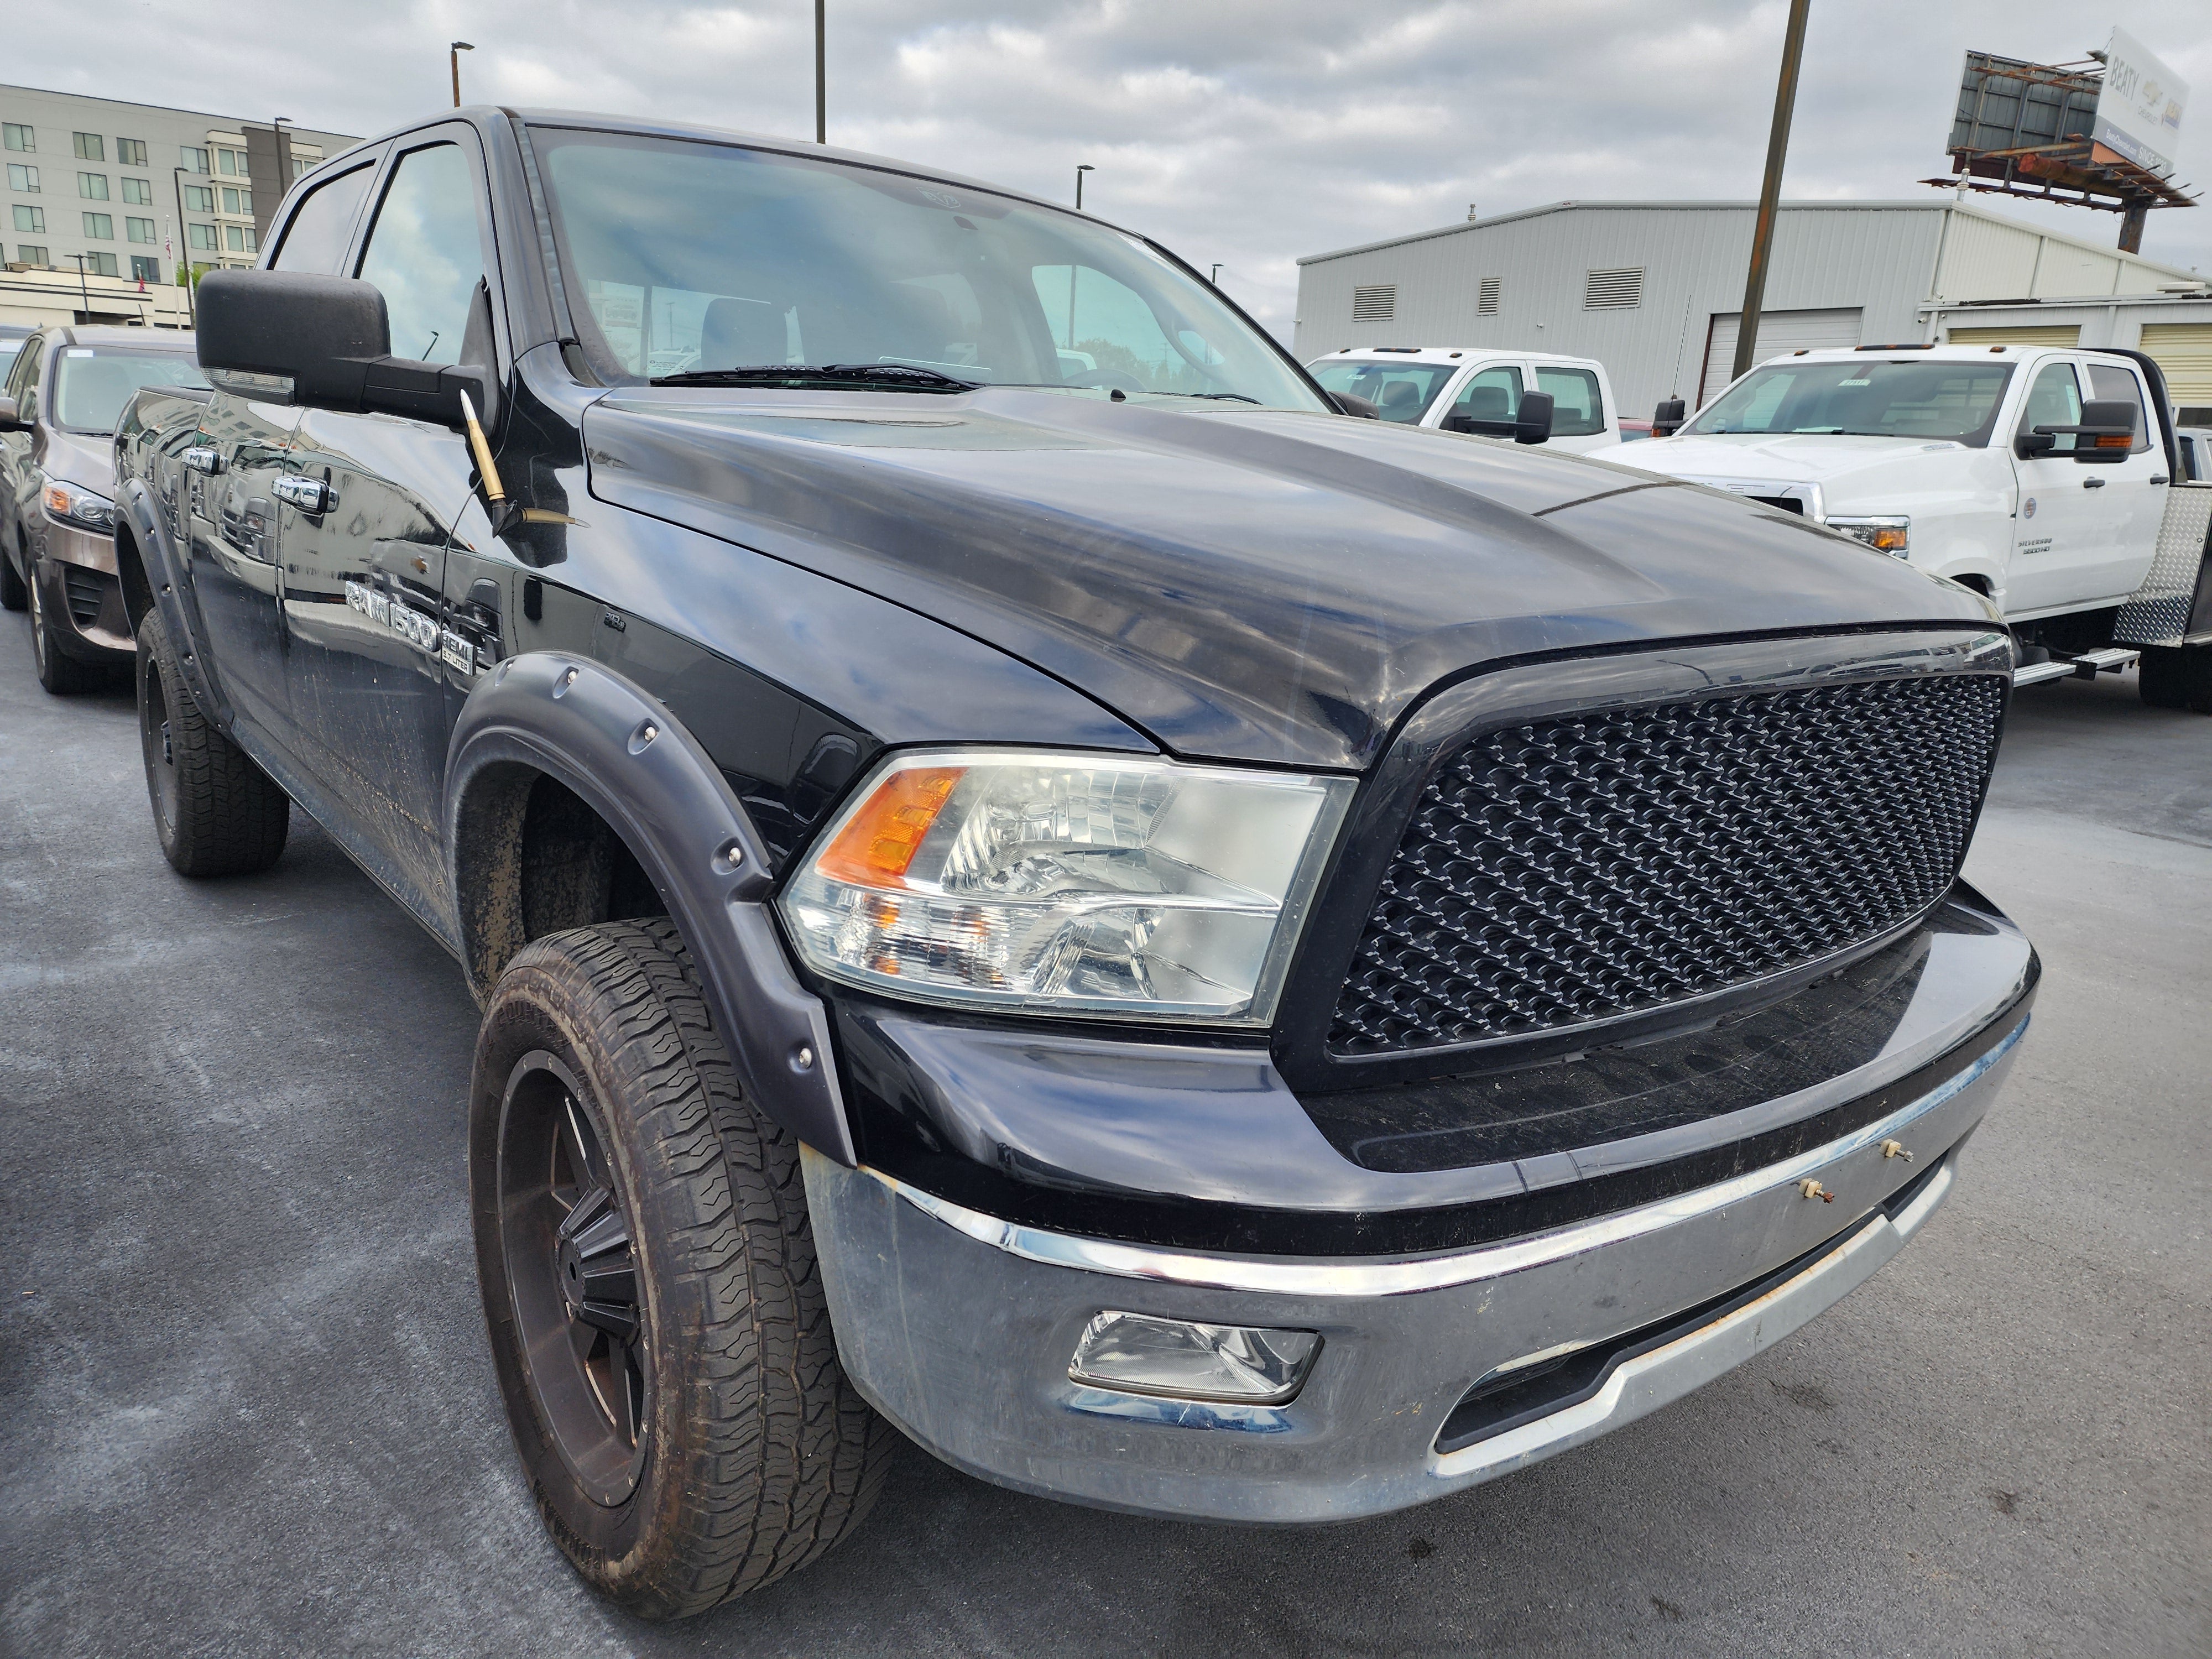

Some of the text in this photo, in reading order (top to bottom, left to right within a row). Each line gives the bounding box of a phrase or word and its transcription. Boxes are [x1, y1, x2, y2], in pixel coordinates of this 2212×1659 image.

[2109, 56, 2140, 101] BEATY
[2138, 147, 2155, 166] SINCE
[345, 580, 438, 653] RAM 1500
[442, 631, 470, 662] HEMI
[443, 649, 468, 672] 5.7 LITER
